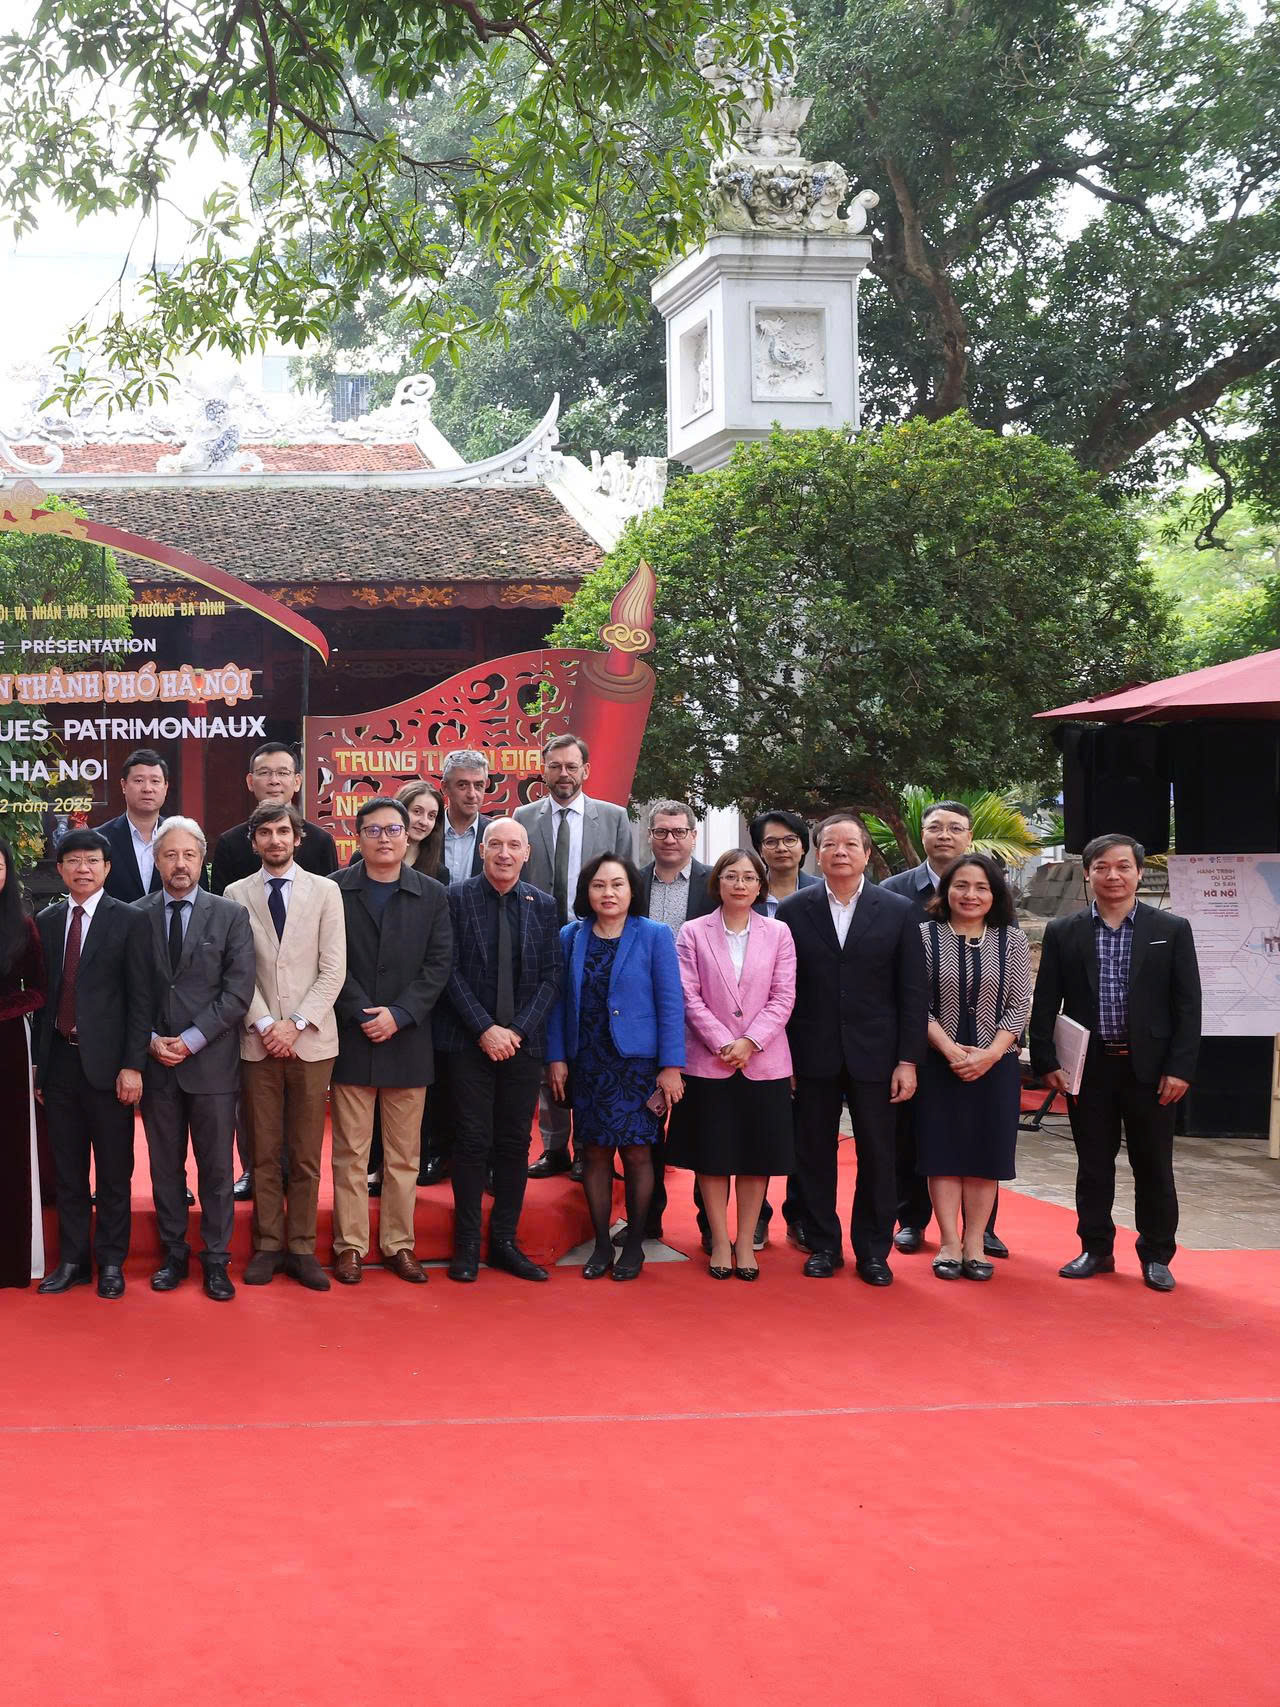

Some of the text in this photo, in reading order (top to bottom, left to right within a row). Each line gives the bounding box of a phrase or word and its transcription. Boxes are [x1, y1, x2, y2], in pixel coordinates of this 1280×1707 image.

[14, 603, 27, 621] VÀ
[132, 600, 174, 618] PHƯỜNG
[180, 602, 195, 616] BA
[200, 598, 225, 616] ĐÌNH
[20, 636, 157, 654] PRÉSENTATION
[20, 668, 100, 700] THÀNH
[106, 663, 156, 698] PHỐ
[162, 666, 196, 698] HÀ
[204, 666, 250, 702] NỘI
[64, 716, 266, 741] PATRIMONIAUX
[10, 760, 50, 782] HA
[58, 759, 108, 781] NOI
[336, 750, 417, 772] TRUNG
[501, 750, 541, 776] ĐỊA
[13, 798, 48, 812] năm
[53, 797, 92, 812] 2025
